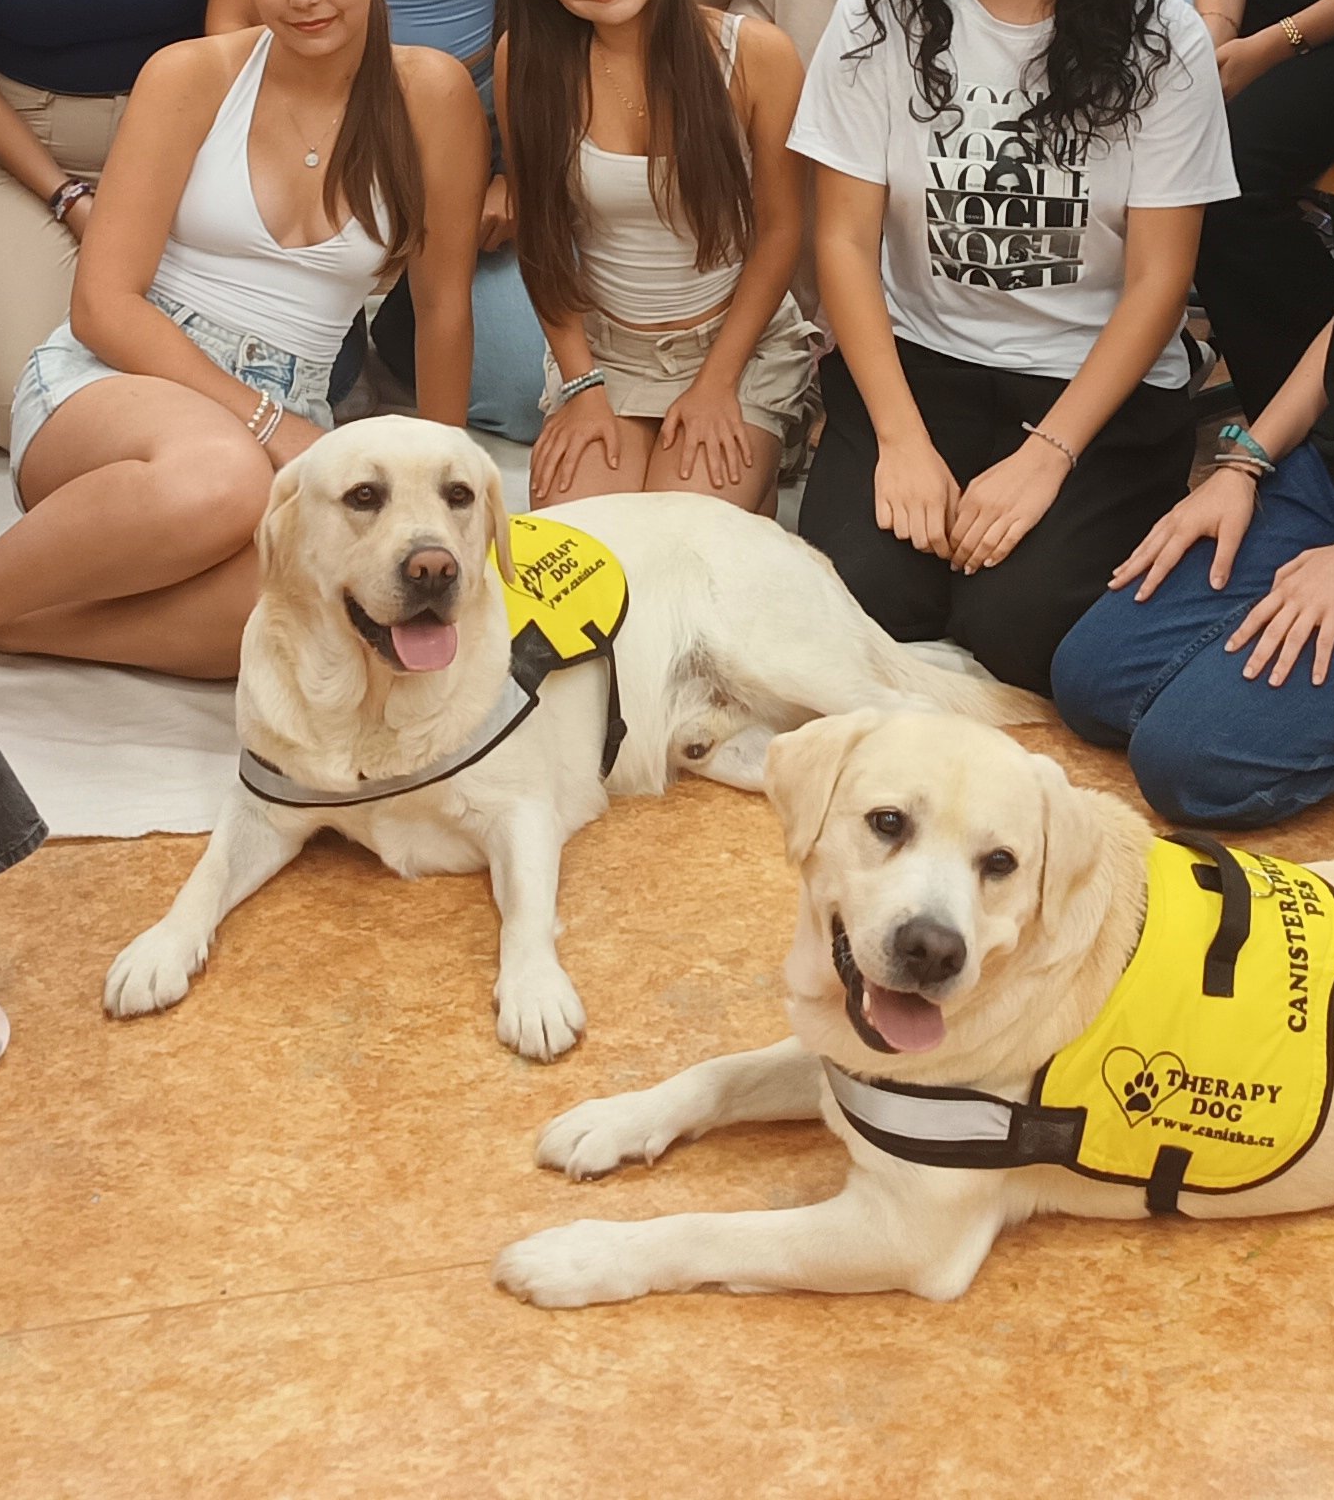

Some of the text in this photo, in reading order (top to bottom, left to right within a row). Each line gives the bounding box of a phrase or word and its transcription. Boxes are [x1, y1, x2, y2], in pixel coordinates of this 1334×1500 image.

[525, 538, 579, 581] THERAPY
[550, 558, 579, 582] DOG
[1293, 879, 1325, 917] PES
[1166, 1069, 1283, 1104] THERAPY
[1189, 1097, 1243, 1122] DOG
